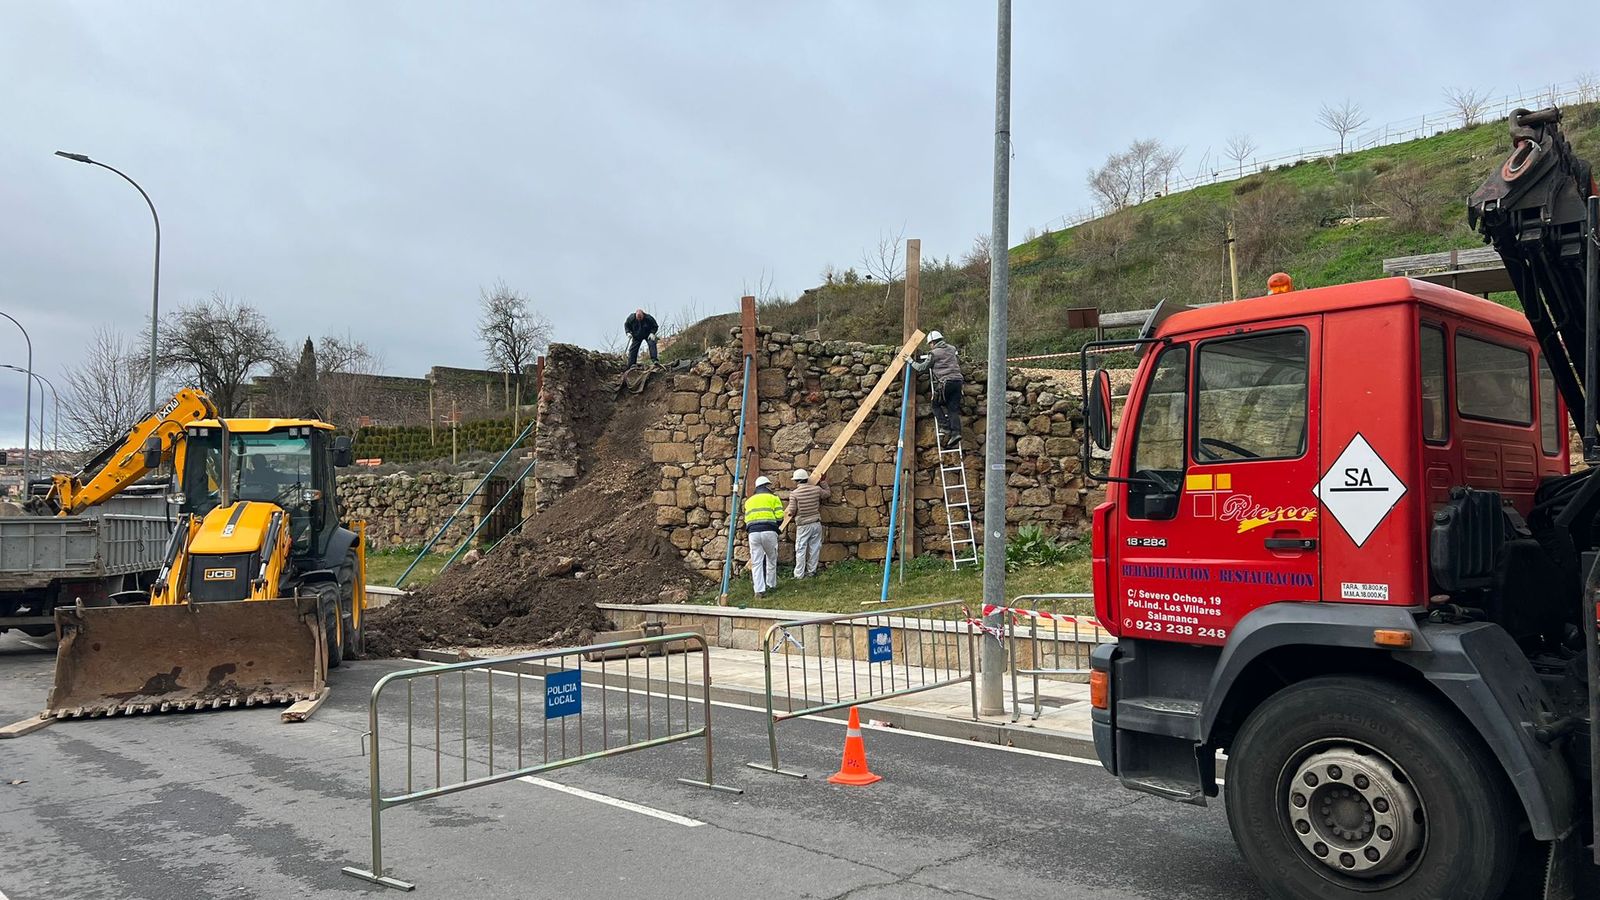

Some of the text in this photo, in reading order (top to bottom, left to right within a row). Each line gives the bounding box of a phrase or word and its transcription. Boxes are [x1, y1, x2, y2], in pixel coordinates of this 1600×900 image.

[1344, 467, 1374, 487] SA
[1219, 494, 1317, 522] Riesco
[206, 570, 234, 578] JCB
[1122, 564, 1314, 586] REHABILITACION RESTAURACION
[1127, 588, 1221, 605] C/ Severo Ochoa, 19
[1128, 599, 1221, 616] Pol.Ind. Los Villares
[1147, 611, 1198, 624] Salamanca
[1135, 620, 1226, 638] 923 238 248
[873, 645, 891, 655] LOCAL
[547, 683, 577, 696] POLICIA
[548, 694, 576, 707] LOCAL
